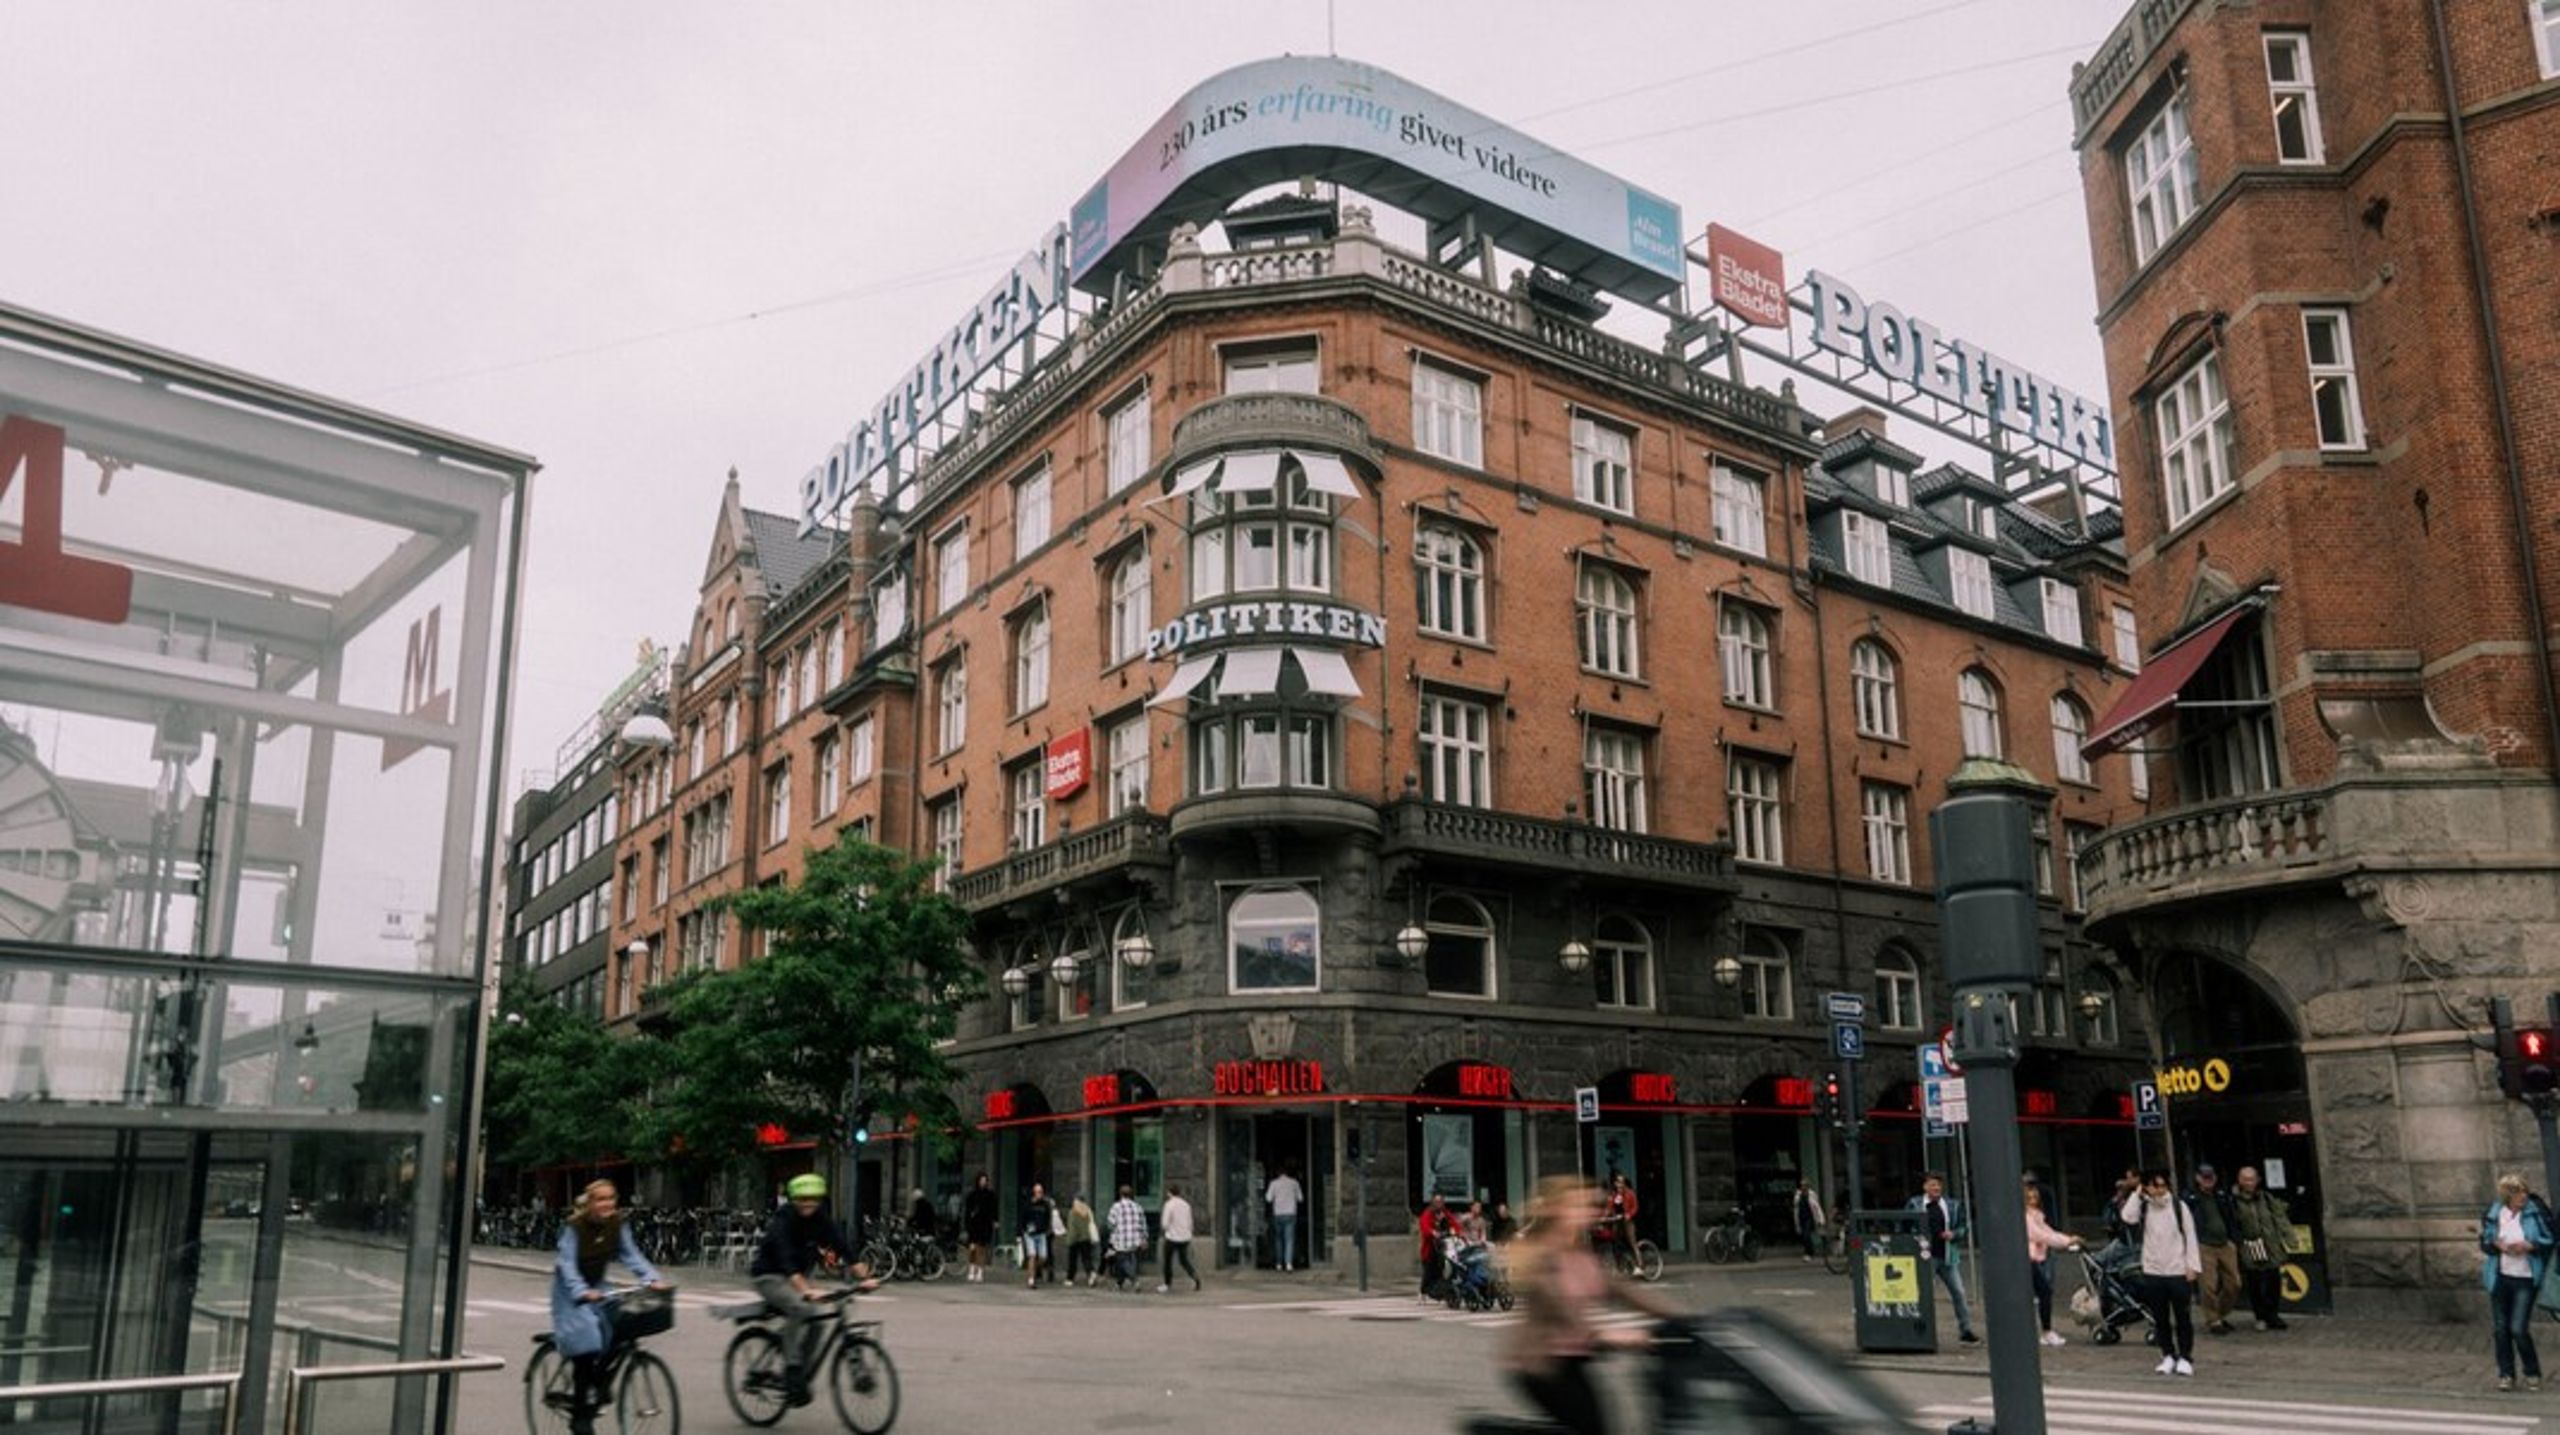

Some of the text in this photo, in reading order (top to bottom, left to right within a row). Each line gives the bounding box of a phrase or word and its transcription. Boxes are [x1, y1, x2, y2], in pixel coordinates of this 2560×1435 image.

[1159, 86, 1557, 198] 230 års erfaring givet videre
[1718, 253, 1781, 299] Ekstra
[1720, 277, 1784, 323] Bladet
[797, 220, 1068, 540] POLITIKEN
[1145, 601, 1388, 660] POLITIKEN
[1215, 1061, 1322, 1094] BOGHALLEN
